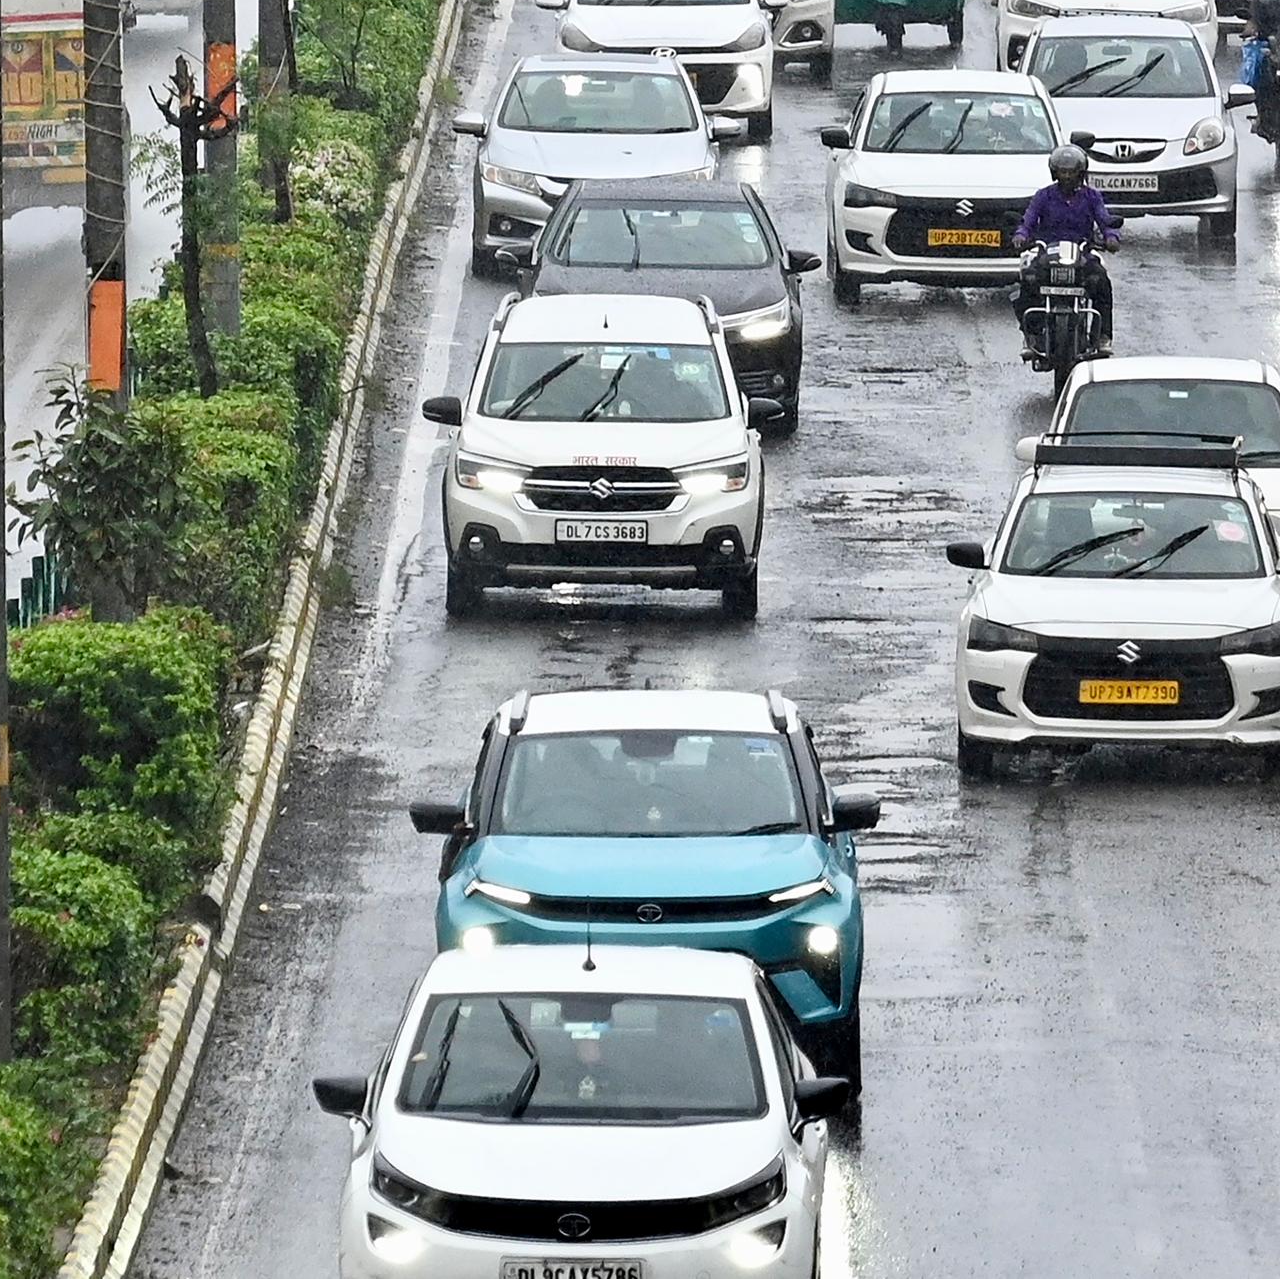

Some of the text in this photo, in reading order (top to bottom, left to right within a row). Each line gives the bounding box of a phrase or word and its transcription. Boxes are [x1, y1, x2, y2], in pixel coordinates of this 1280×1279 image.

[28, 124, 60, 140] NIGHT
[934, 231, 1000, 244] UP23BT4504
[572, 455, 638, 467] भारत सरकार
[1089, 685, 1178, 701] UP79AT7390
